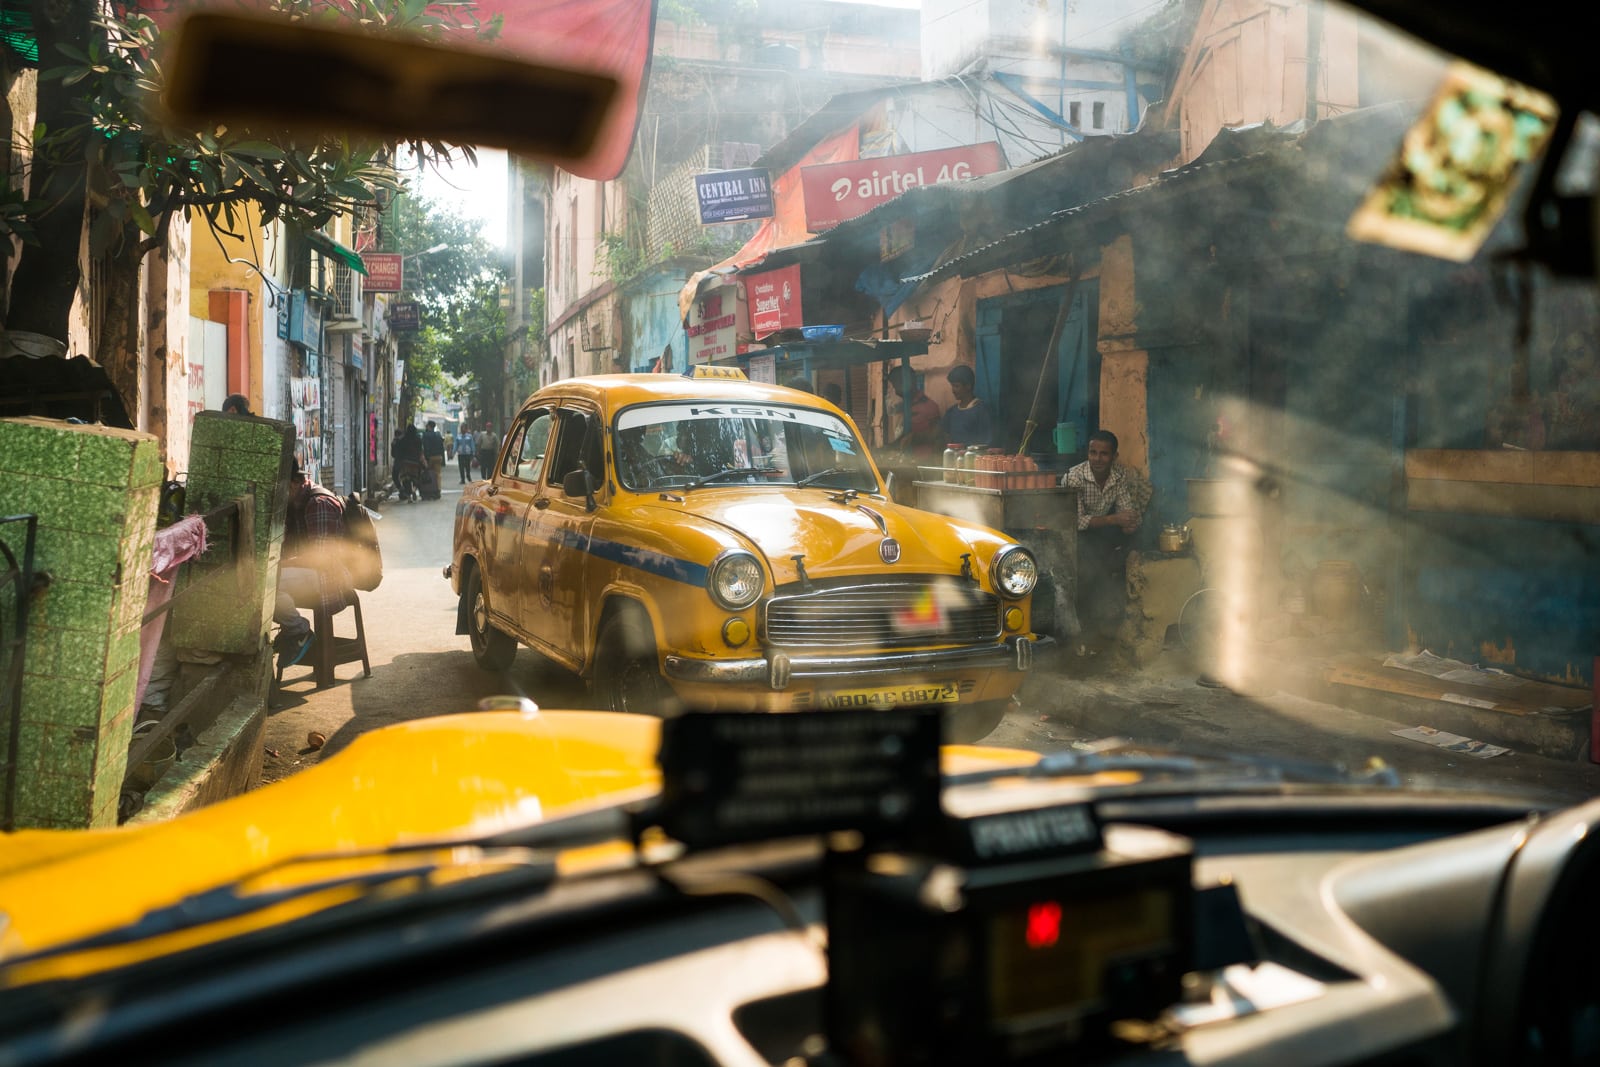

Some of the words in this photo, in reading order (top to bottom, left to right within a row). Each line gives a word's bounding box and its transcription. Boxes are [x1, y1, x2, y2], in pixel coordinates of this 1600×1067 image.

[857, 167, 925, 198] airtel
[936, 161, 972, 185] 4G
[700, 180, 744, 199] CENTRAL
[748, 176, 767, 193] INN
[371, 262, 399, 274] CHANGER
[699, 368, 739, 378] TAXI
[690, 407, 797, 420] KGN
